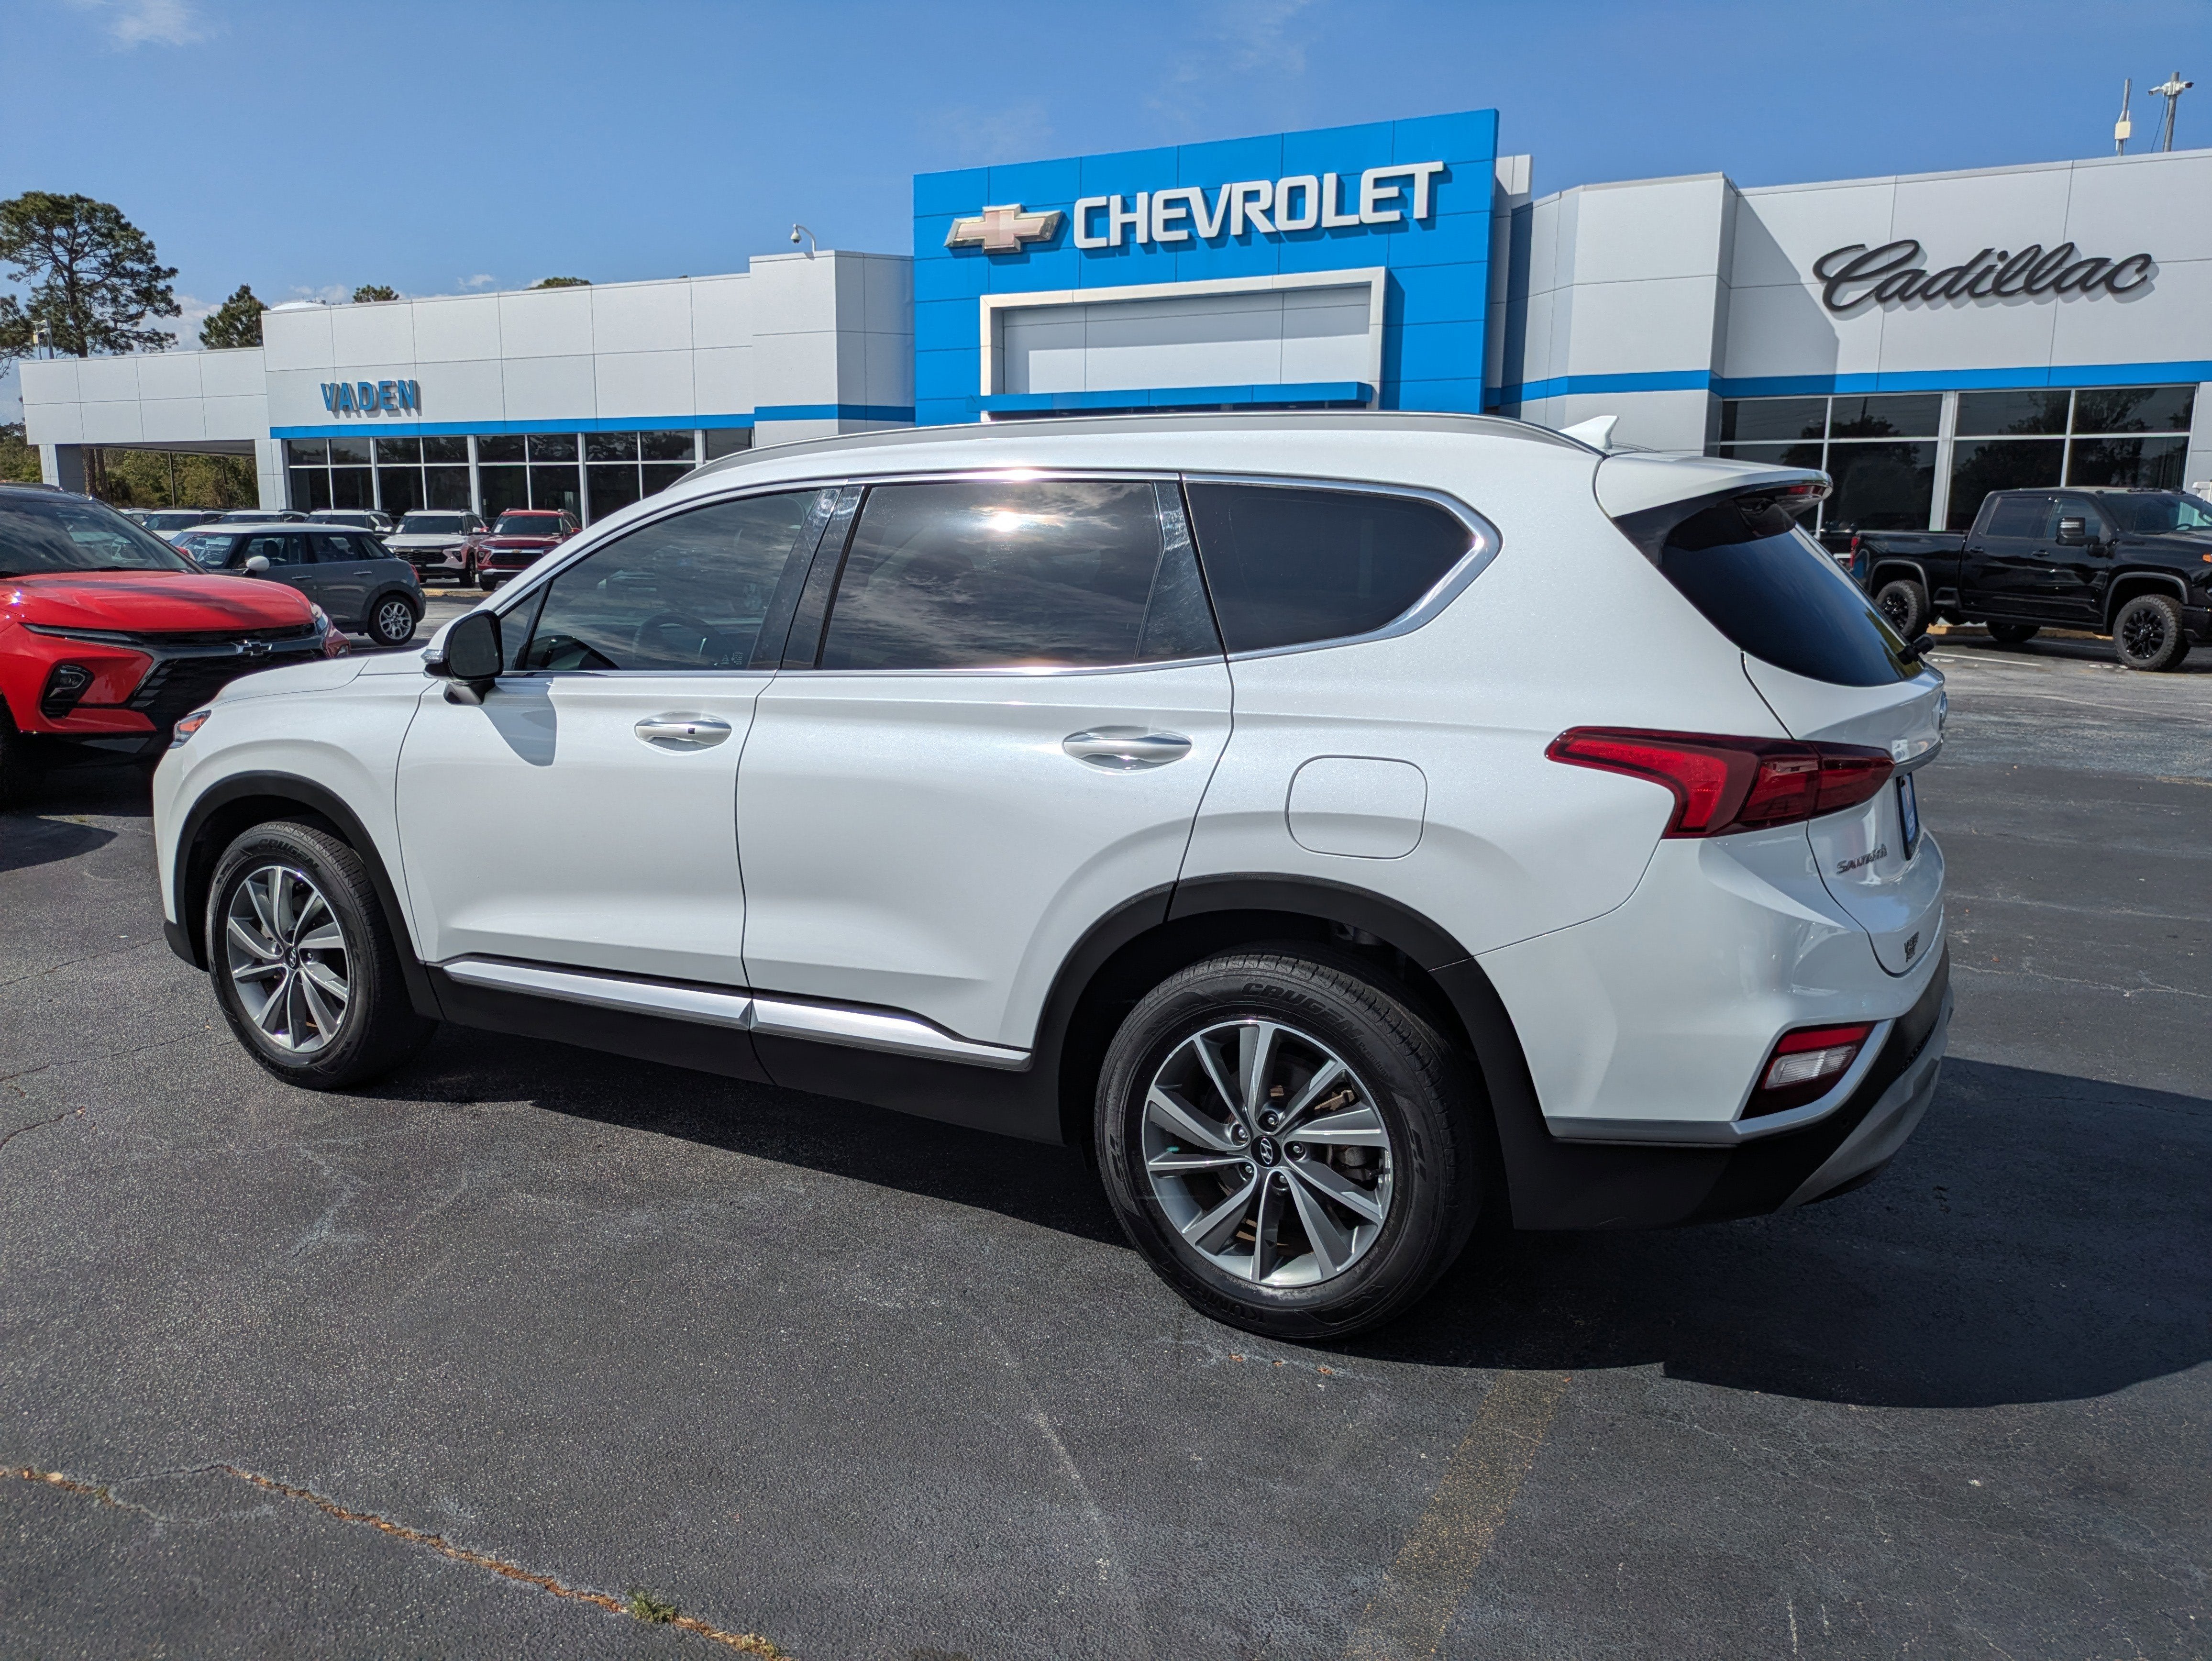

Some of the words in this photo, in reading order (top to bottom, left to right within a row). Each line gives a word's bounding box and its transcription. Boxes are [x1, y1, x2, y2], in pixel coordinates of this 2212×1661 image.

[1073, 161, 1444, 249] CHEVROLET
[1812, 239, 2153, 311] Cadillac
[320, 380, 415, 411] VADEN
[258, 839, 320, 870] CRUGEN
[1242, 983, 1365, 1040] CRUGEN
